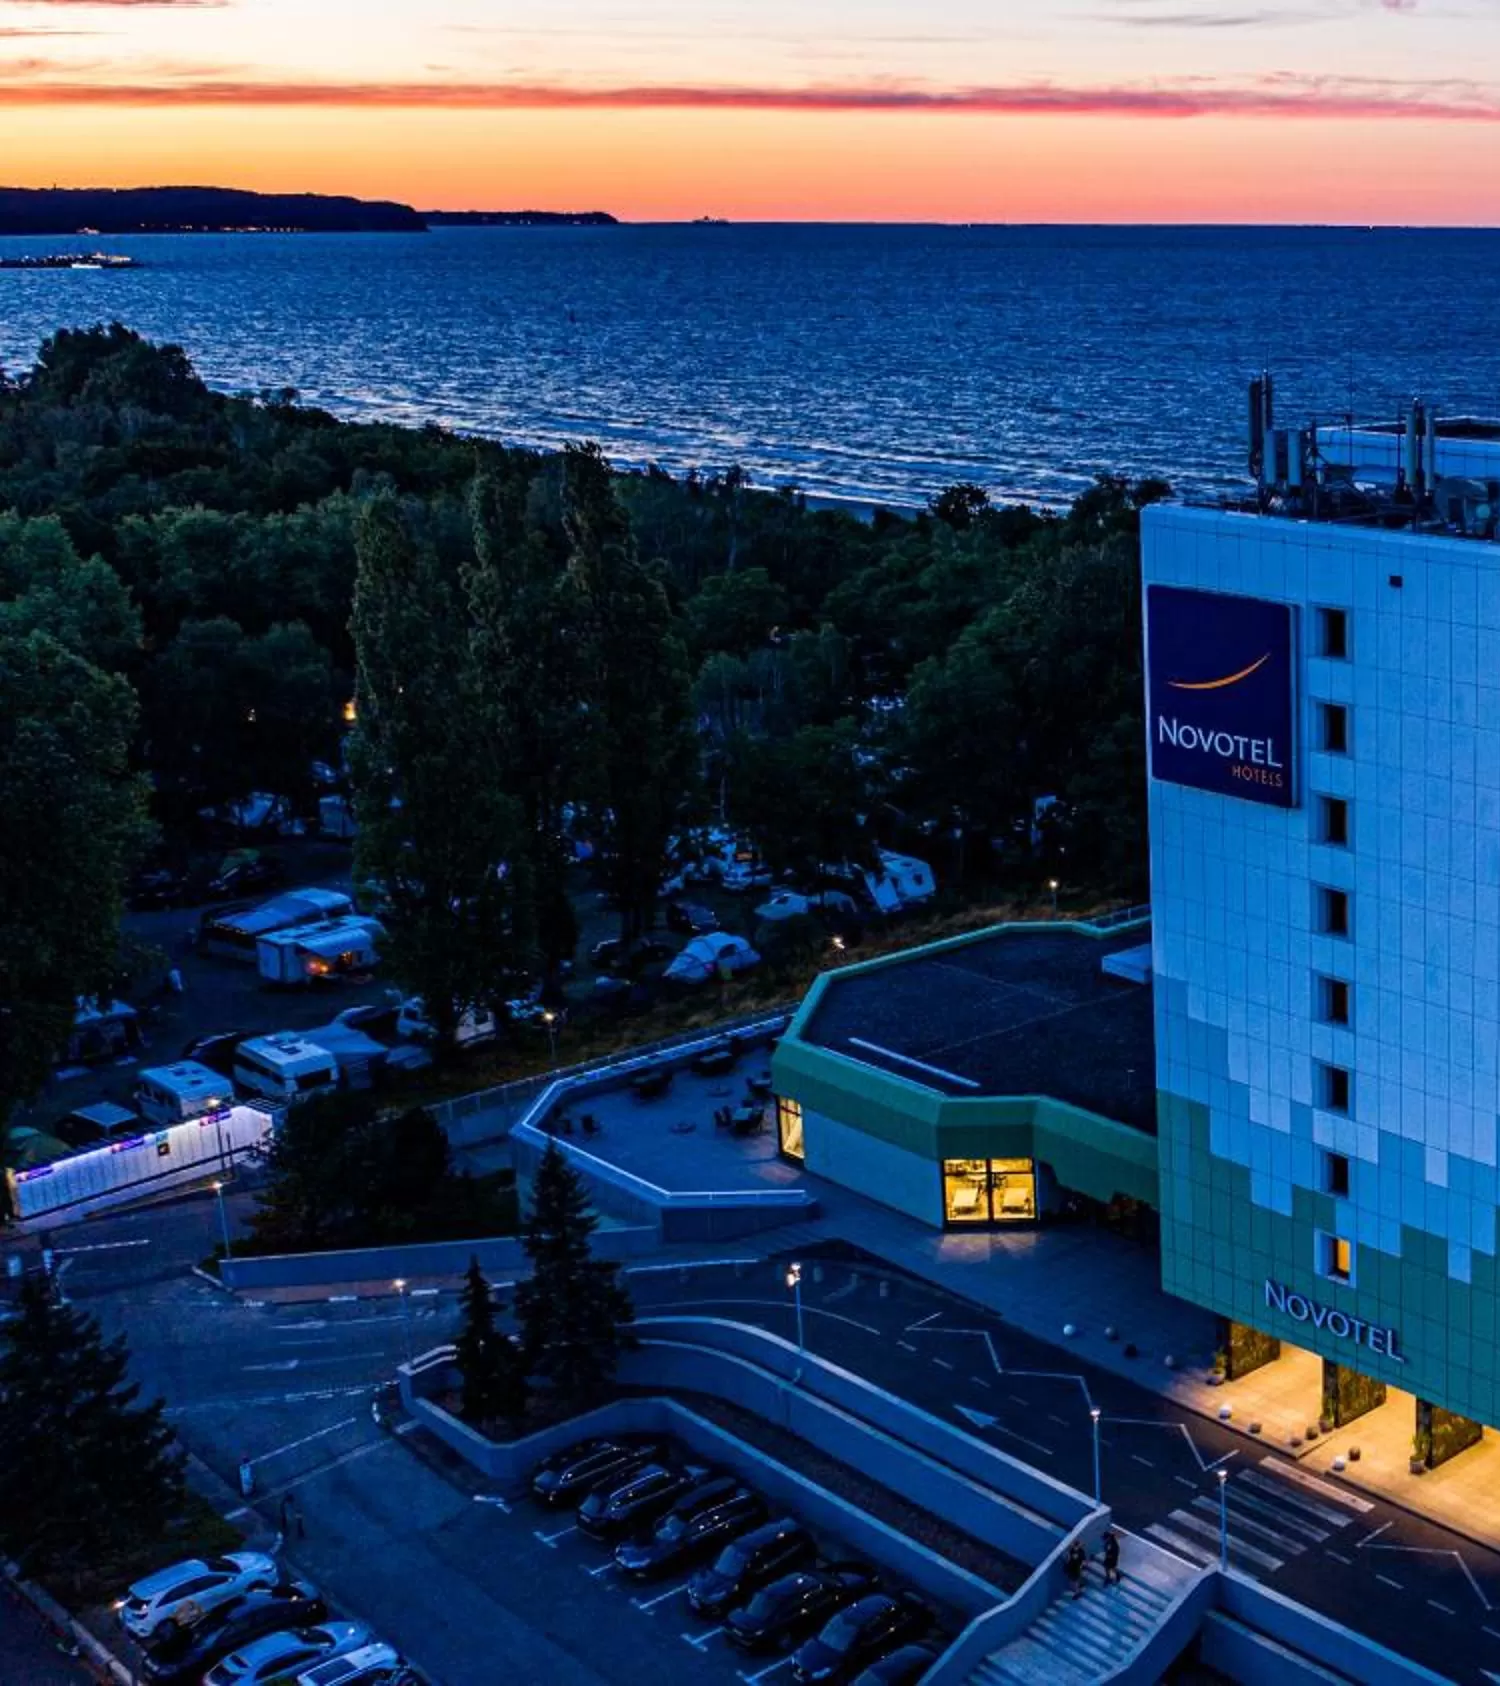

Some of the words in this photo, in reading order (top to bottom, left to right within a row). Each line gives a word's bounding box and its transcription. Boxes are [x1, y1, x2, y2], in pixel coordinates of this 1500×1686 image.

[1157, 714, 1284, 769] NOVOTEL
[1231, 764, 1284, 788] HOTELS
[1264, 1279, 1405, 1364] NOVOTEL
